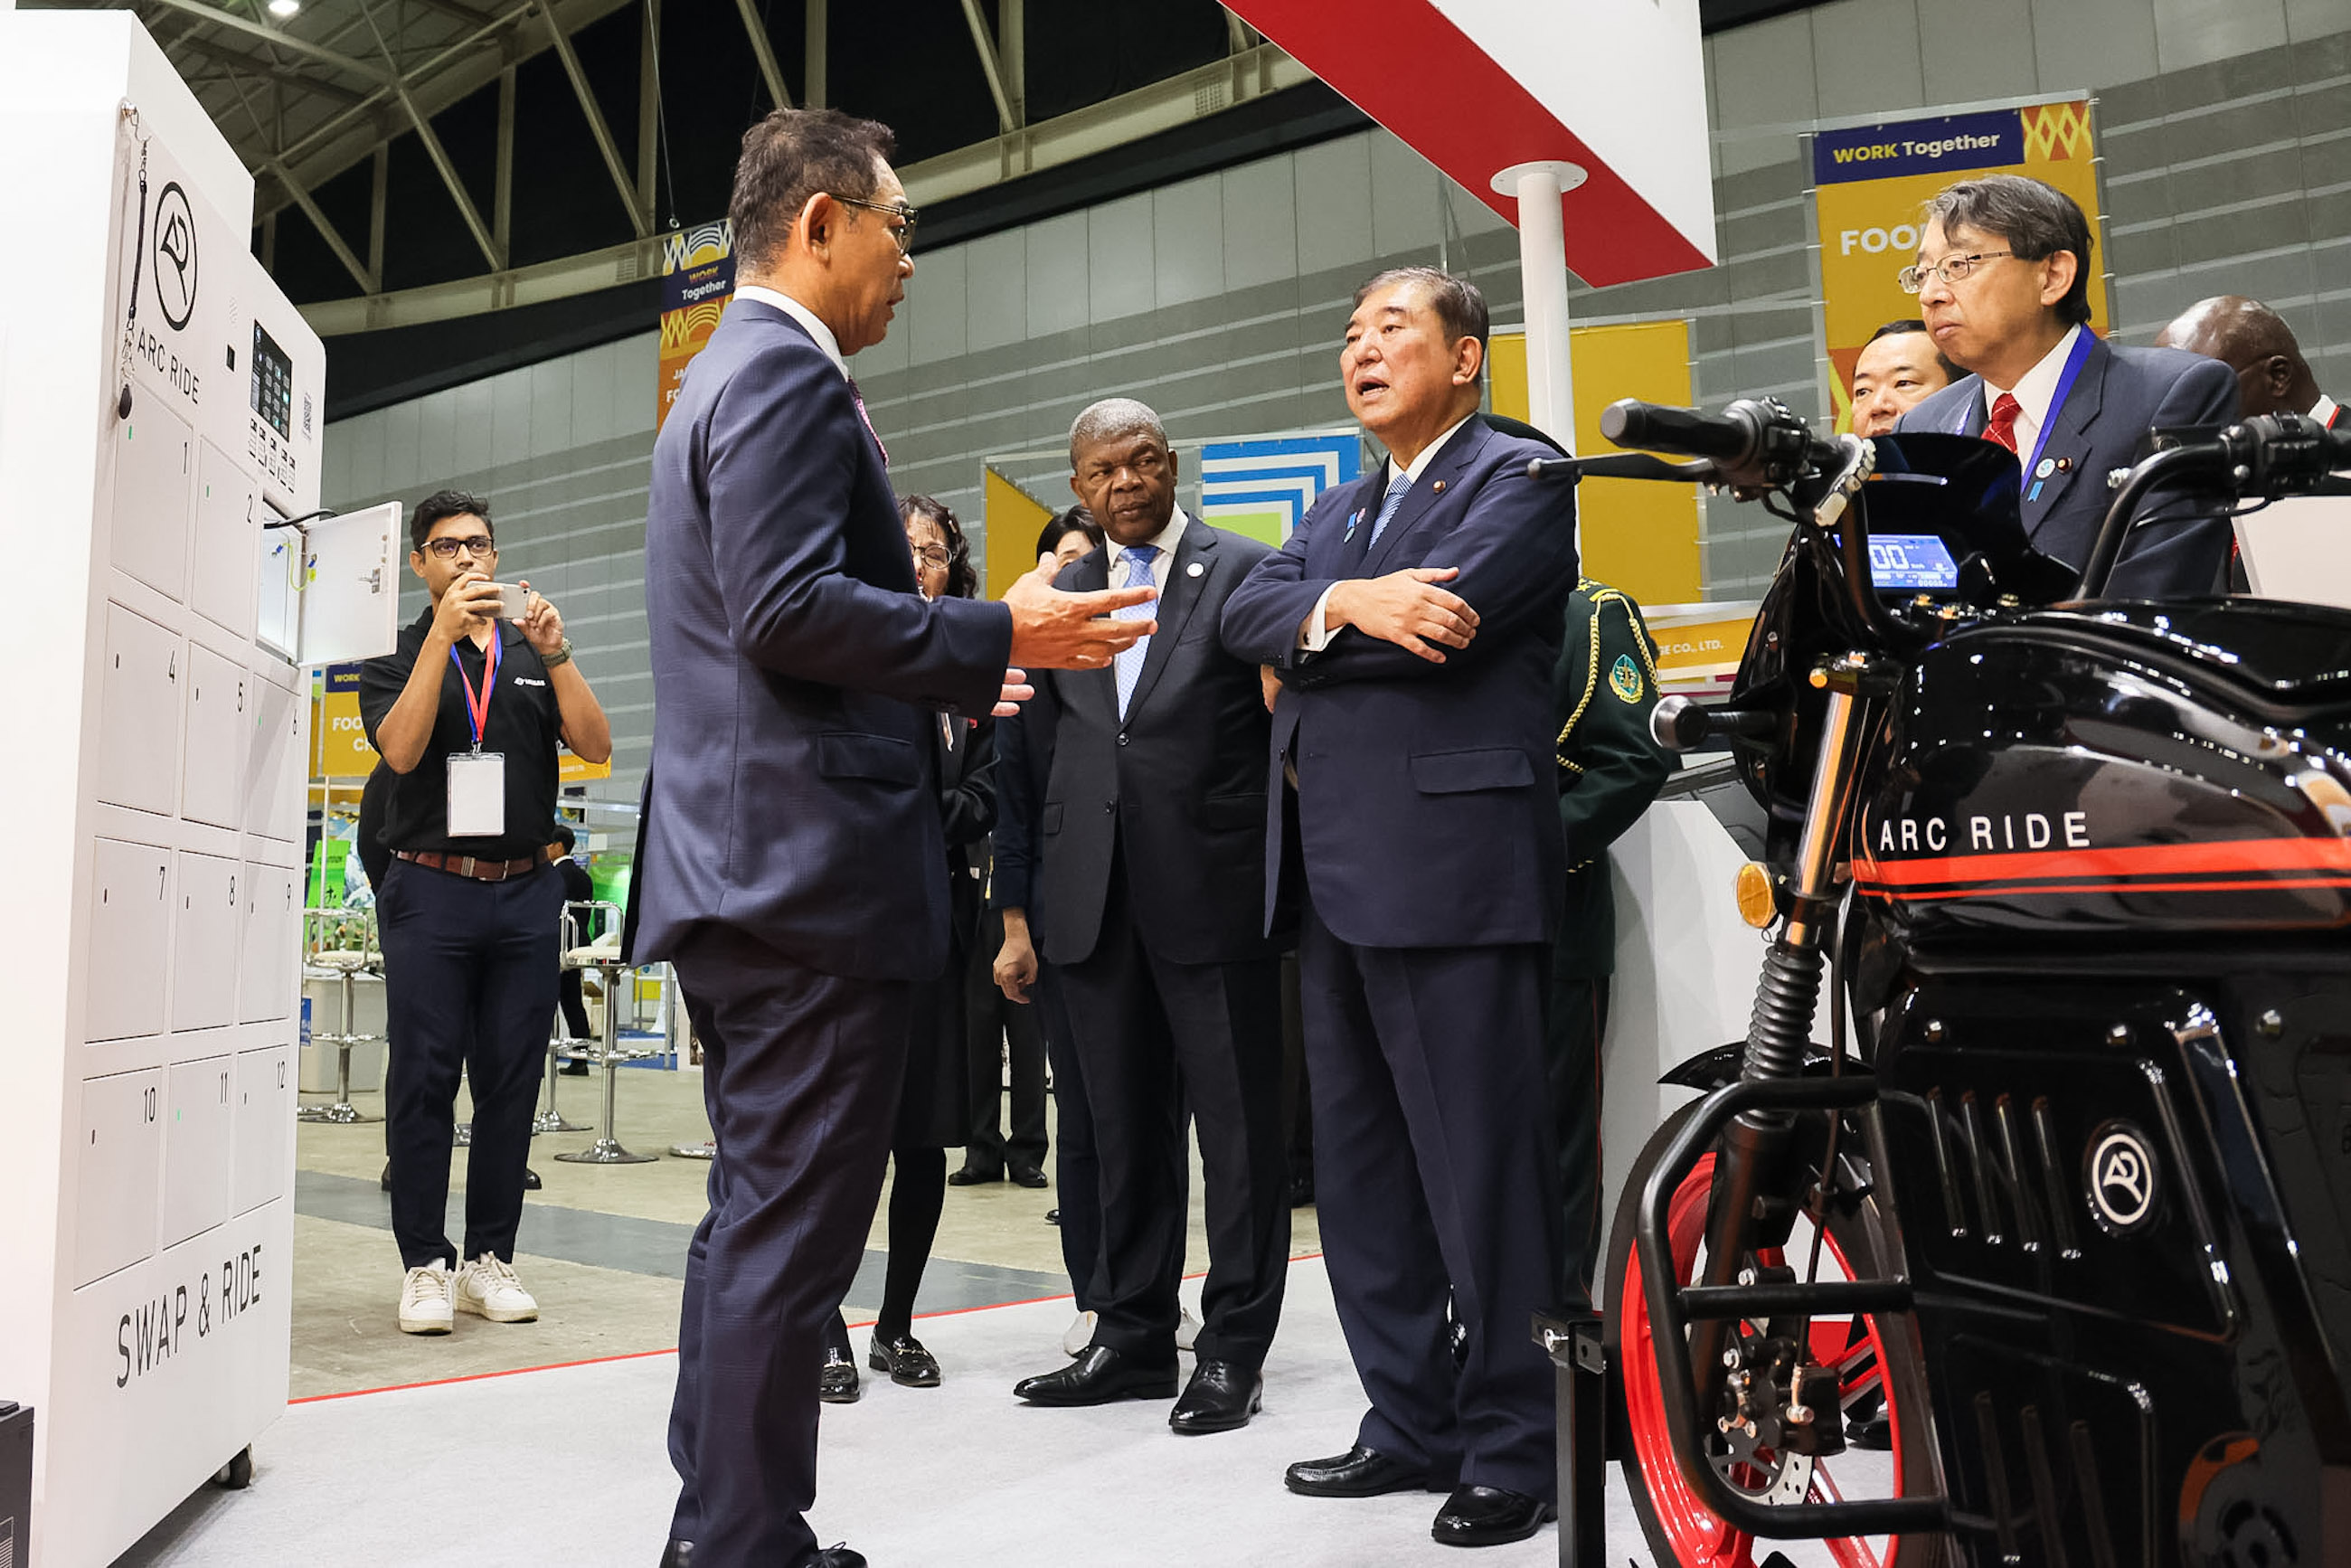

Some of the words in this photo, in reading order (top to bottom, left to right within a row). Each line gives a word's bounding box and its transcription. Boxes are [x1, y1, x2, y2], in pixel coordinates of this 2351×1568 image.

[1833, 143, 1898, 164] WORK
[1903, 134, 2000, 158] Together
[682, 279, 726, 300] Together
[689, 266, 719, 283] WORK
[137, 326, 165, 372] ARC
[169, 355, 200, 404] RIDE
[246, 494, 252, 524] 2
[1699, 639, 1724, 652] LTD.
[168, 650, 175, 685] 4
[334, 674, 361, 683] WORK
[237, 682, 243, 713] 5
[291, 709, 297, 735] 6
[333, 716, 364, 731] FOO
[1879, 817, 1947, 852] ARC
[1971, 811, 2091, 851] RIDE
[159, 865, 165, 901] 7
[229, 875, 235, 906] 8
[287, 883, 292, 911] 9
[221, 1072, 228, 1104] 11
[277, 1061, 286, 1091] 12
[145, 1086, 156, 1124] 10
[116, 1285, 187, 1389] SWAP
[197, 1272, 211, 1337] &
[222, 1244, 262, 1325] RIDE
